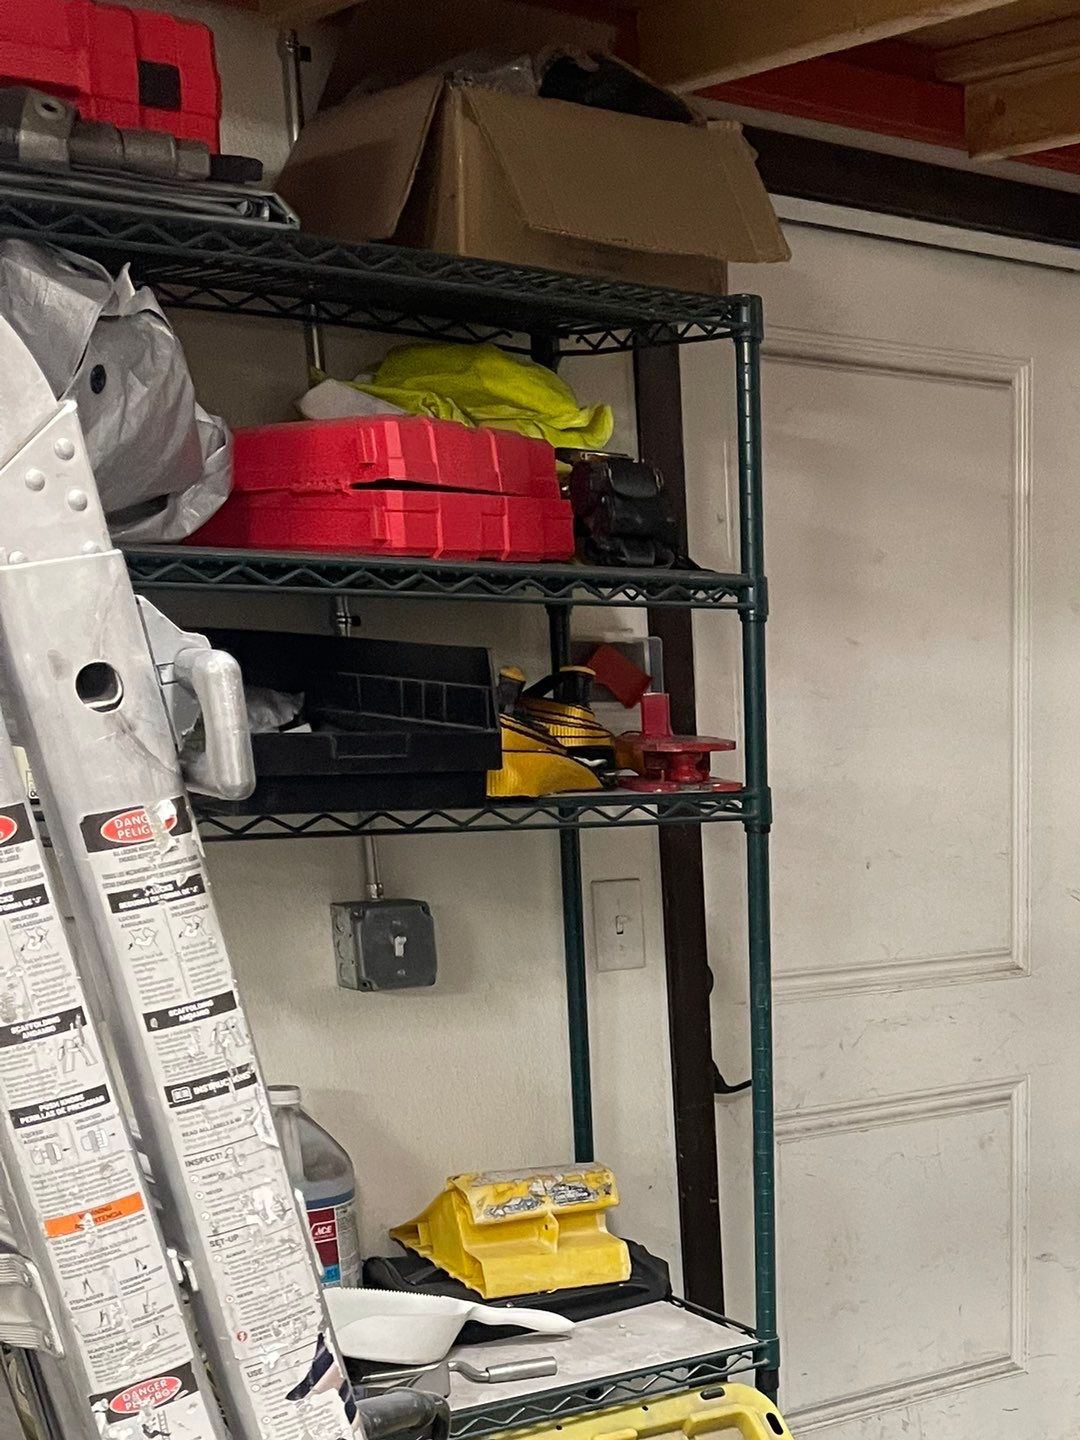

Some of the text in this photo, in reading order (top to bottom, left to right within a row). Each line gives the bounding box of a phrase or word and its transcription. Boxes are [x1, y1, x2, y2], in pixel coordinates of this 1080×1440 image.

[114, 814, 149, 829] DANG
[117, 825, 150, 840] PELIG
[193, 1072, 251, 1096] INSTRUCIONS
[314, 1224, 333, 1236] ACE
[122, 1379, 168, 1403] DANGER
